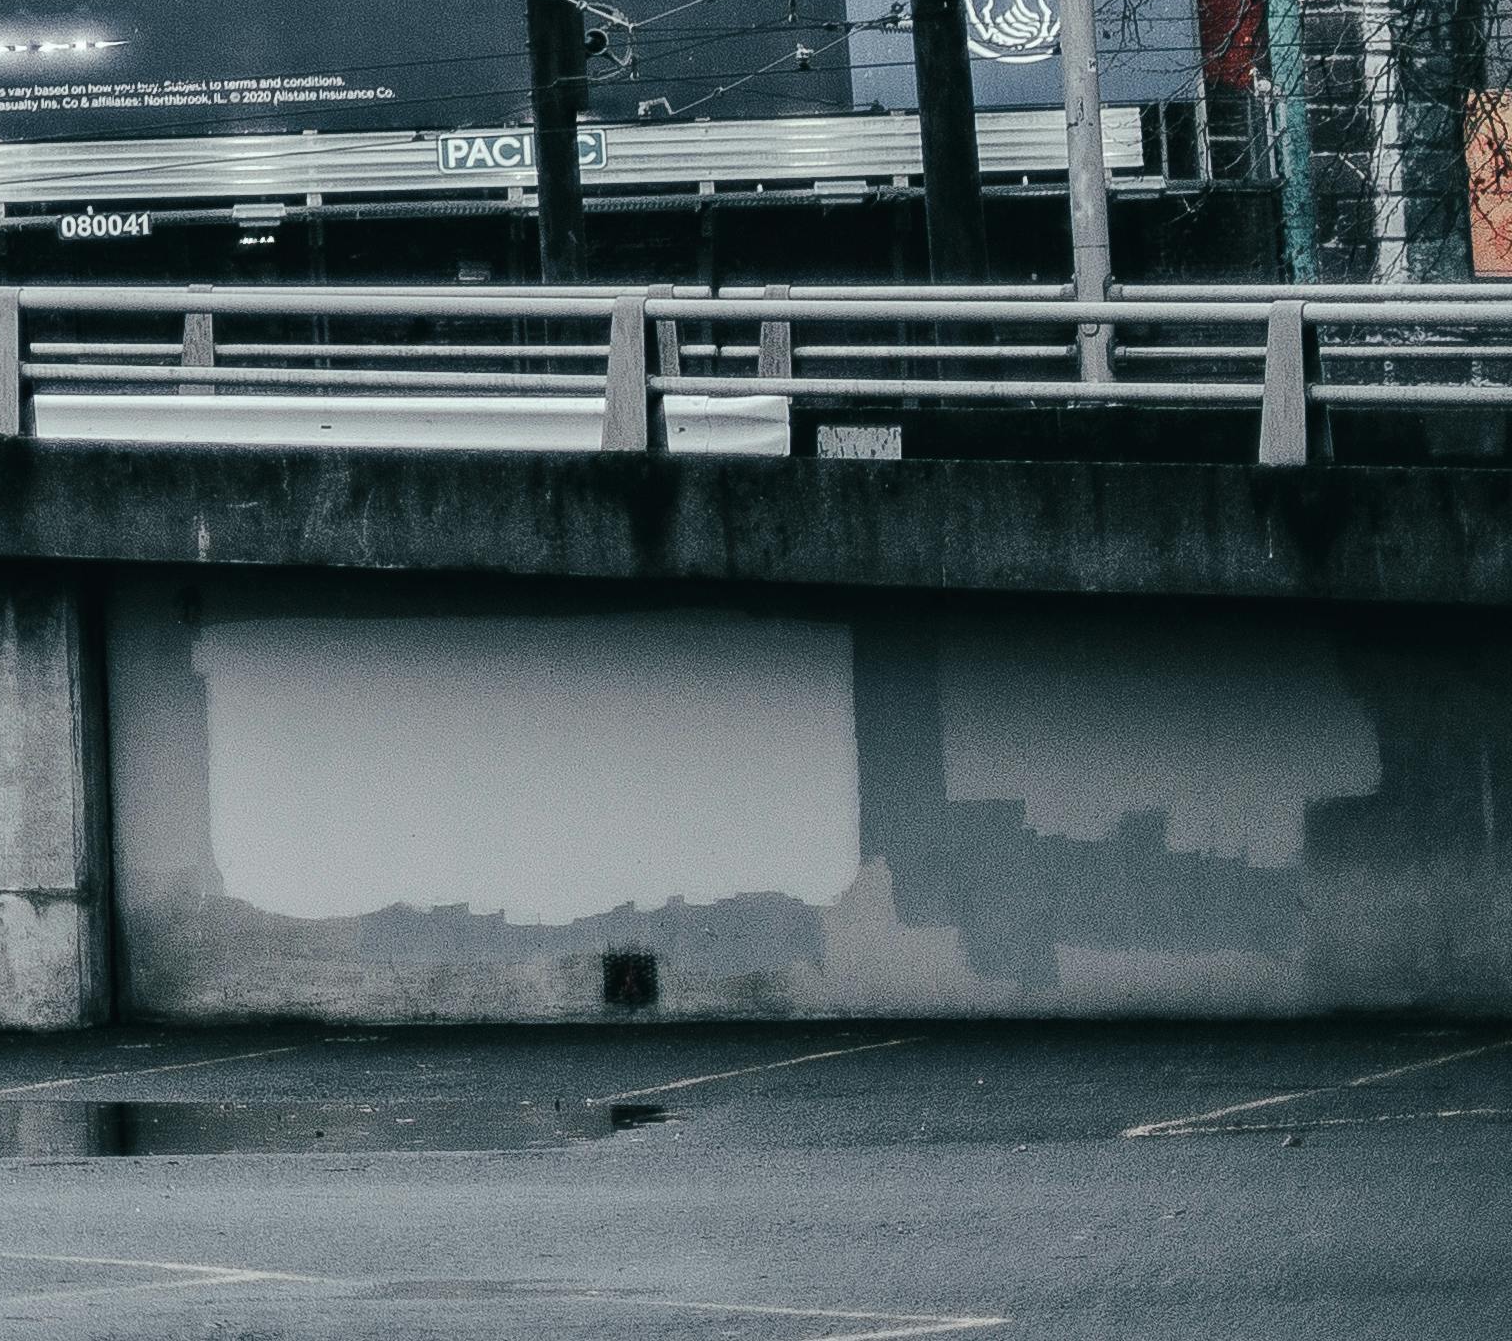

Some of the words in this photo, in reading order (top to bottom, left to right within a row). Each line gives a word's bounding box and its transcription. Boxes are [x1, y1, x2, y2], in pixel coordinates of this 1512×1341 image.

[8, 86, 32, 99] vary
[34, 85, 69, 96] based
[71, 86, 86, 95] on
[88, 83, 112, 94] how
[114, 84, 136, 96] you
[163, 80, 206, 93] Subject
[209, 80, 222, 91] to
[224, 79, 258, 90] terms
[259, 76, 282, 88] and
[283, 75, 346, 88] conditions.
[62, 97, 79, 108] Co
[80, 97, 90, 108] &
[144, 93, 212, 106] Northbrook,
[229, 92, 241, 103] ©
[242, 91, 272, 103] 2020
[274, 90, 317, 104] Allstate
[319, 89, 375, 100] Insurance
[447, 134, 597, 168] PACIC
[61, 213, 151, 238] 080041
